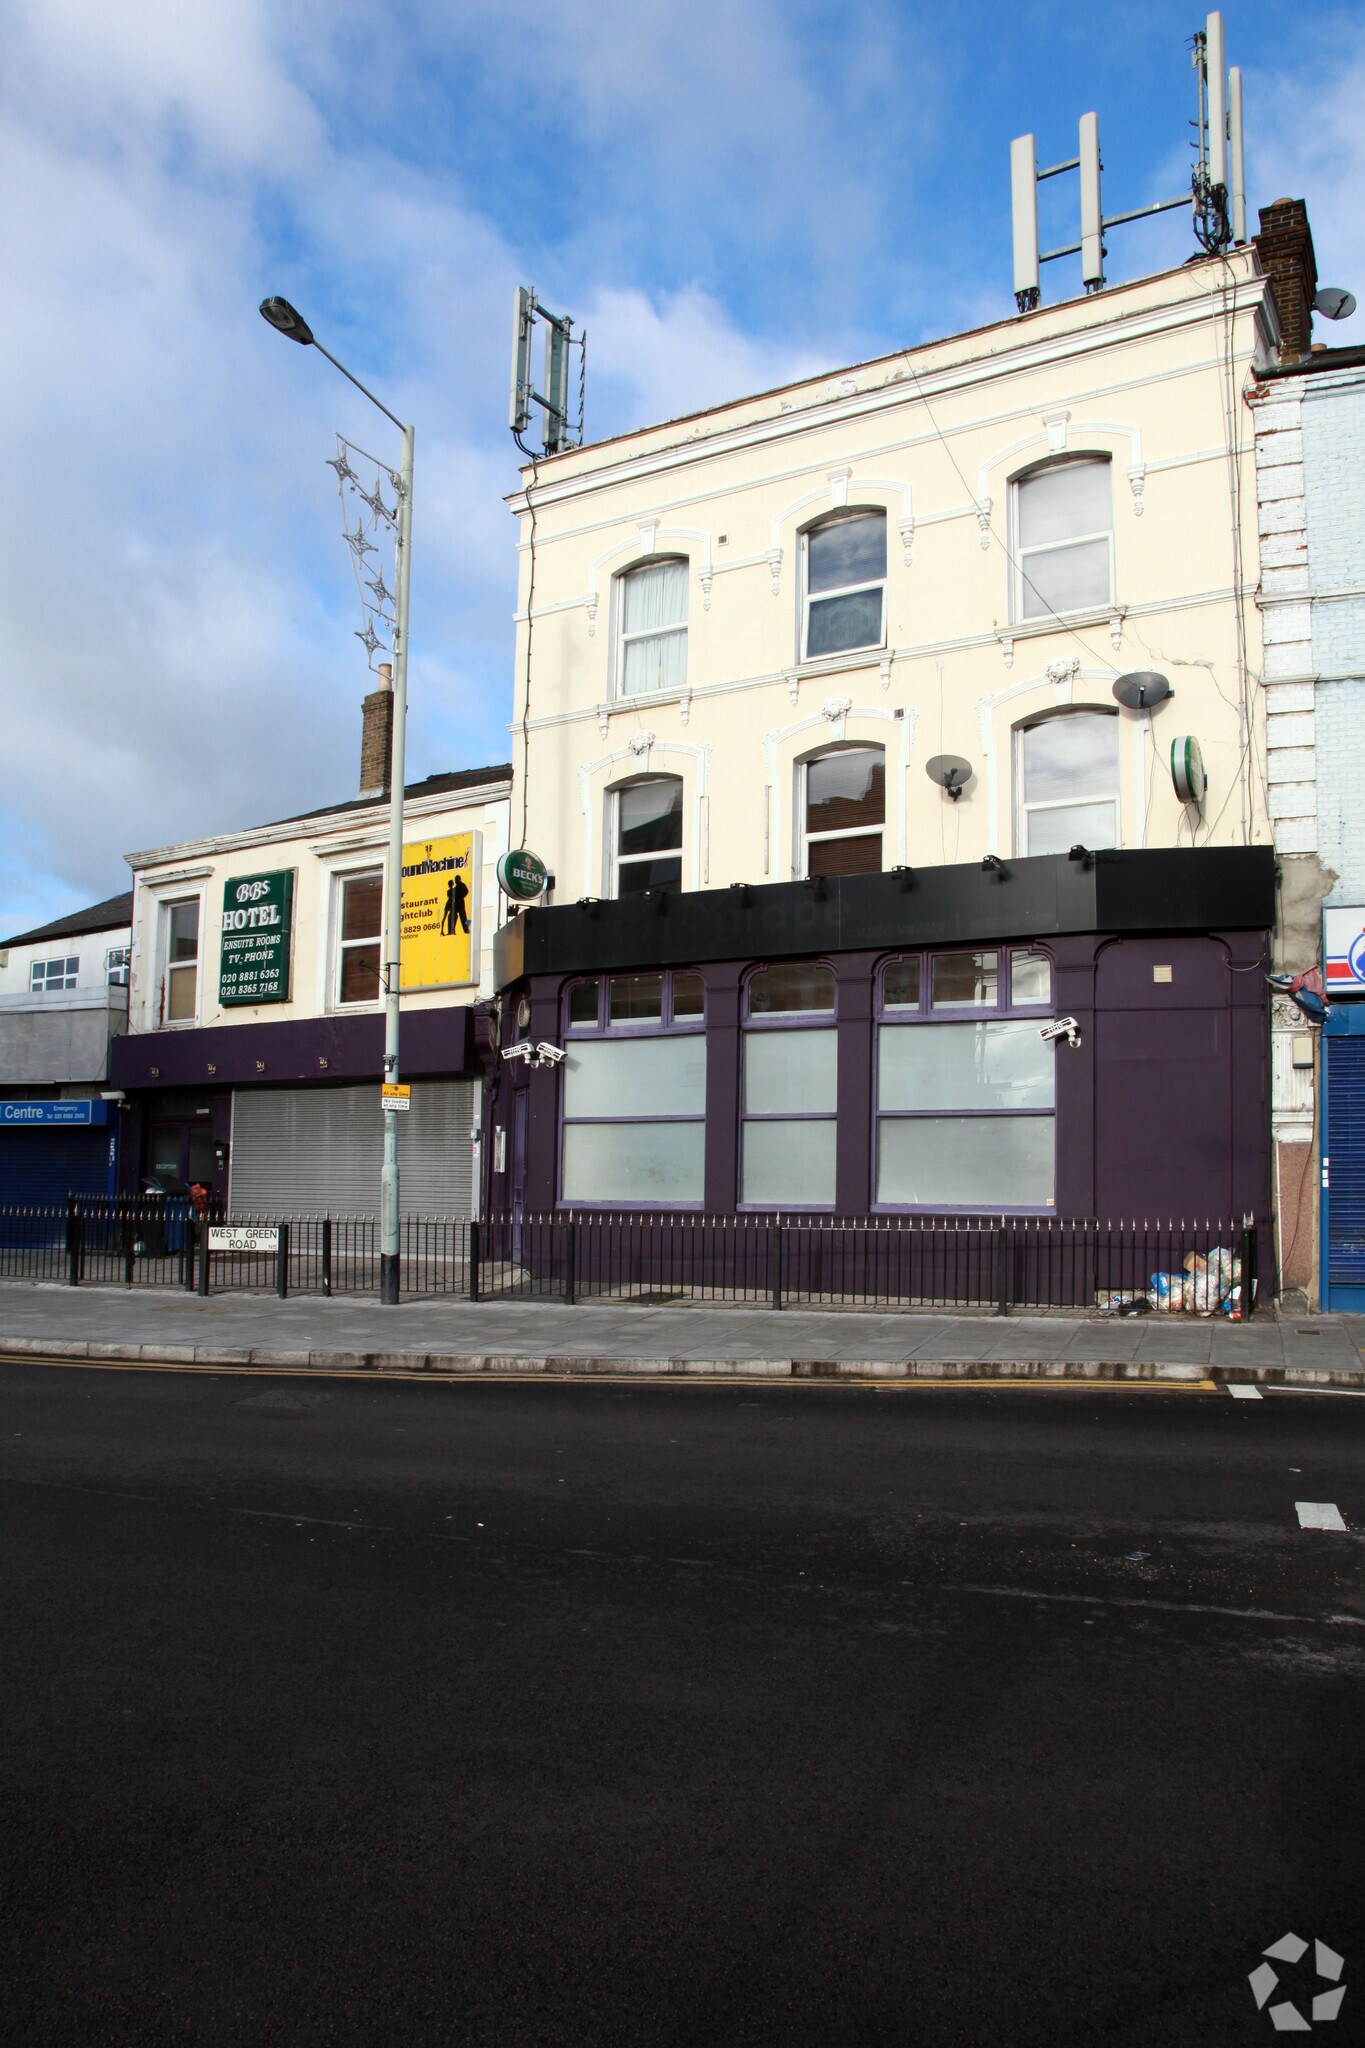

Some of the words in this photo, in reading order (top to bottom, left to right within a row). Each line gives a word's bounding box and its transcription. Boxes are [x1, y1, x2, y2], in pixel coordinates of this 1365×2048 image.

[402, 856, 465, 877] oundMachine
[513, 868, 544, 884] BECK'S
[401, 897, 438, 909] staurant
[223, 904, 281, 931] HOTEL
[400, 909, 433, 922] ghtclub
[404, 925, 421, 934] 8829
[423, 922, 441, 931] 0666
[224, 938, 254, 950] ENSUITE
[256, 935, 281, 946] ROOMS
[222, 973, 237, 983] 020
[239, 971, 258, 981] 8881
[260, 968, 279, 978] 6363
[221, 986, 236, 995] 020
[238, 984, 257, 994] 8365
[259, 981, 278, 992] 7168
[5, 1105, 43, 1119] Centre
[211, 1228, 238, 1238] WEST
[245, 1229, 278, 1239] GREEN
[229, 1240, 257, 1249] ROAD
